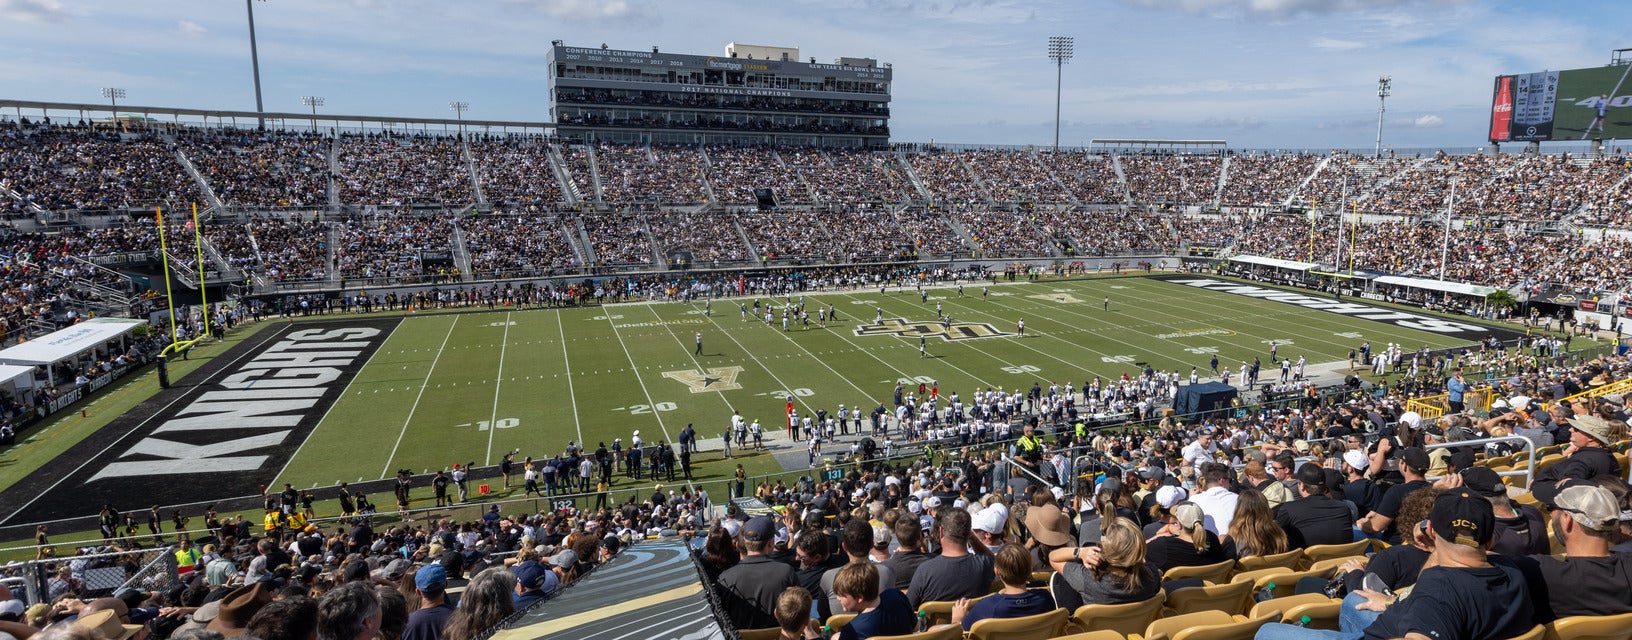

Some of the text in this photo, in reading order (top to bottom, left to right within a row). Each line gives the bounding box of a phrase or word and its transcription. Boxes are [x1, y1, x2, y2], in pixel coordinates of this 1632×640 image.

[565, 48, 653, 59] CONFERENCE CHAMPIONS
[704, 87, 743, 95] NATIONAL
[746, 89, 792, 97] CHAMPIONS
[128, 252, 147, 262] FUND
[1001, 365, 1041, 374] 50
[896, 375, 936, 386] 40
[770, 388, 815, 400] 30
[84, 327, 382, 484] KNIGHTS
[629, 401, 678, 415] 20
[476, 417, 520, 431] 10
[828, 470, 842, 481] 131
[480, 485, 490, 494] 10
[552, 500, 573, 511] 132
